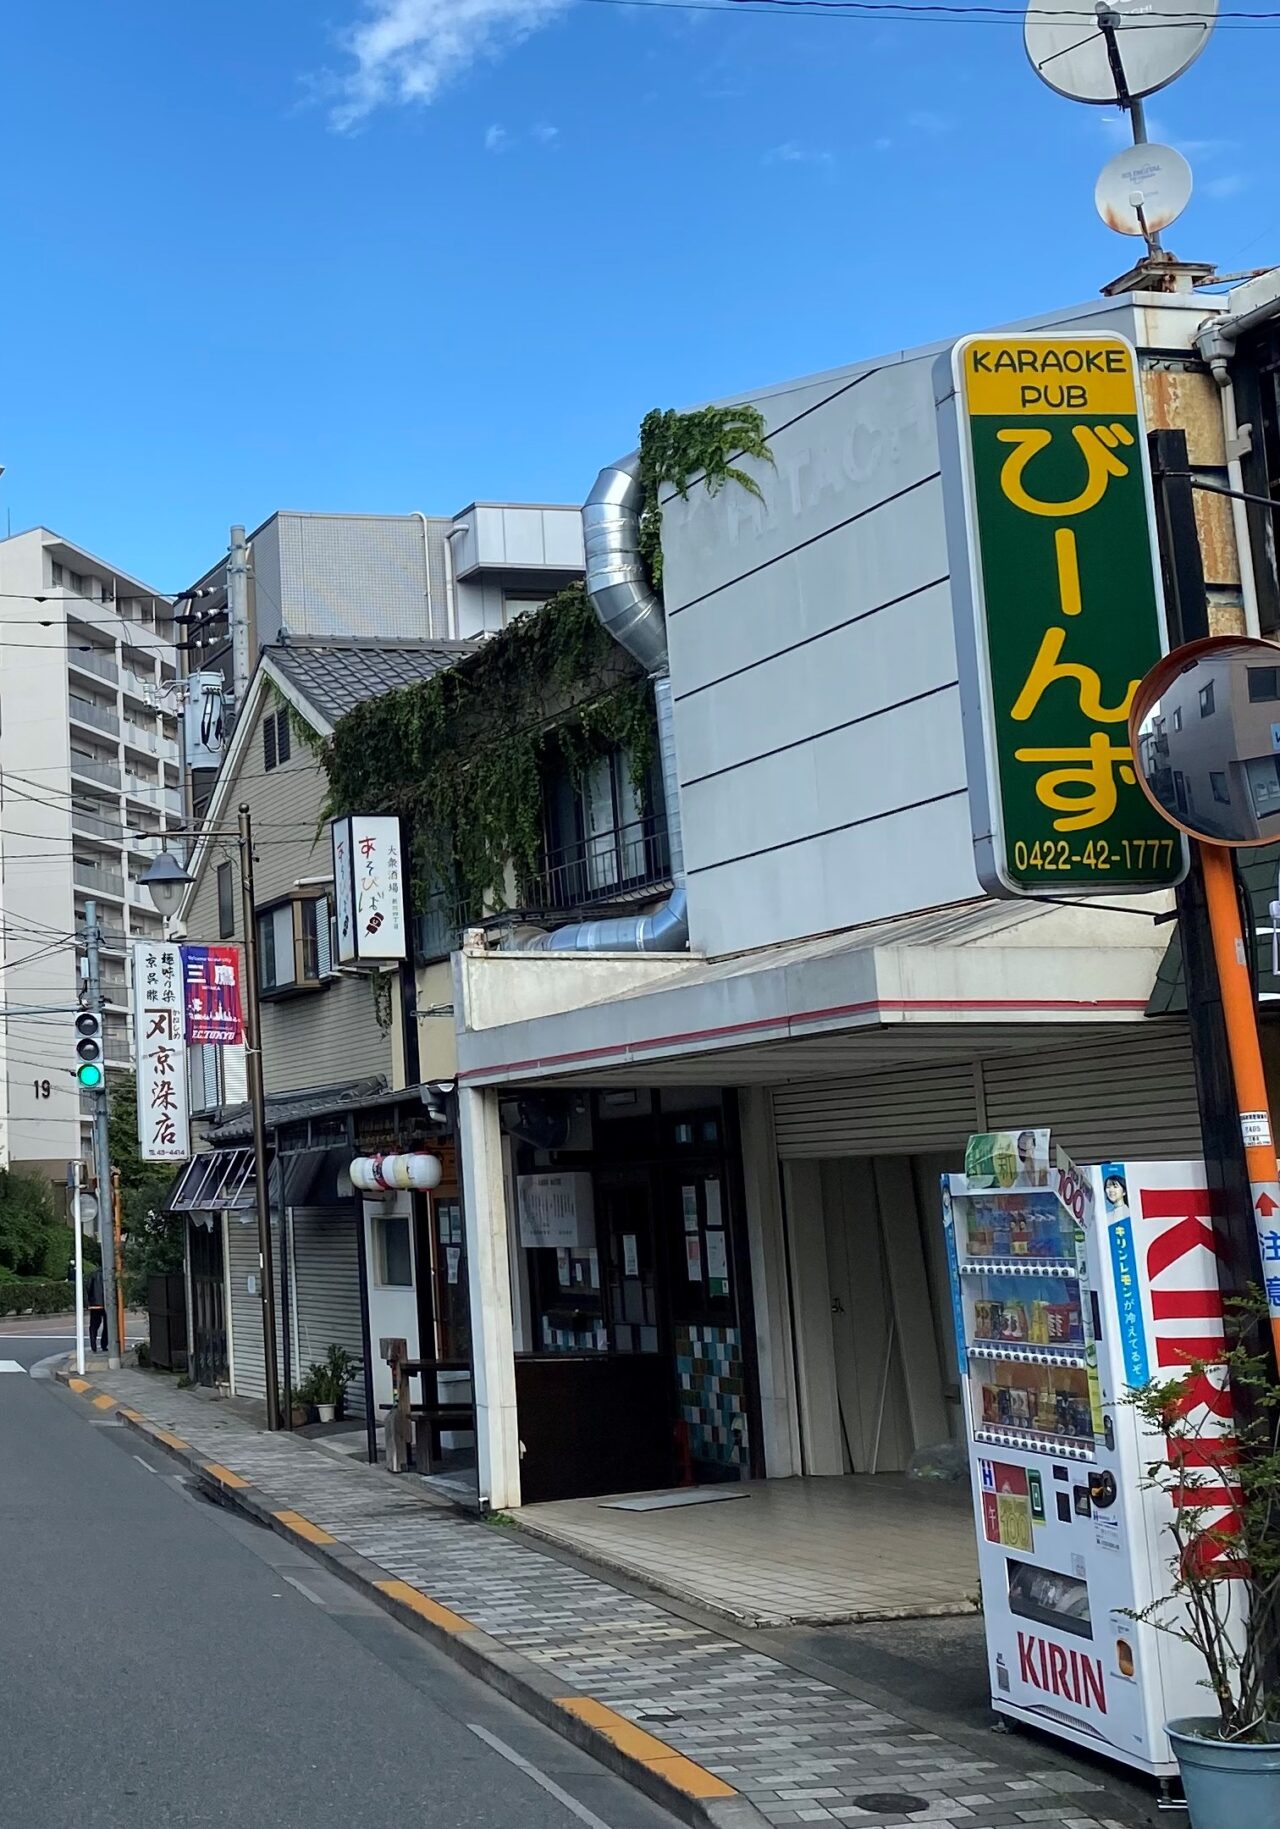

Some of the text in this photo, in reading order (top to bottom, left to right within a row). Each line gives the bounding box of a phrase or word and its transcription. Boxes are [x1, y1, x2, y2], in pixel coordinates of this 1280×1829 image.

[972, 349, 1127, 373] KARAOKE
[1020, 385, 1088, 408] PUB
[996, 422, 1143, 832] びーんず
[388, 845, 399, 894] 大衆酒場
[1014, 839, 1174, 871] 0422-42-1777
[186, 964, 236, 986] 三鷹
[33, 1079, 51, 1099] 19
[148, 1045, 178, 1145] 京染店
[1016, 1630, 1108, 1715] KIRIN
